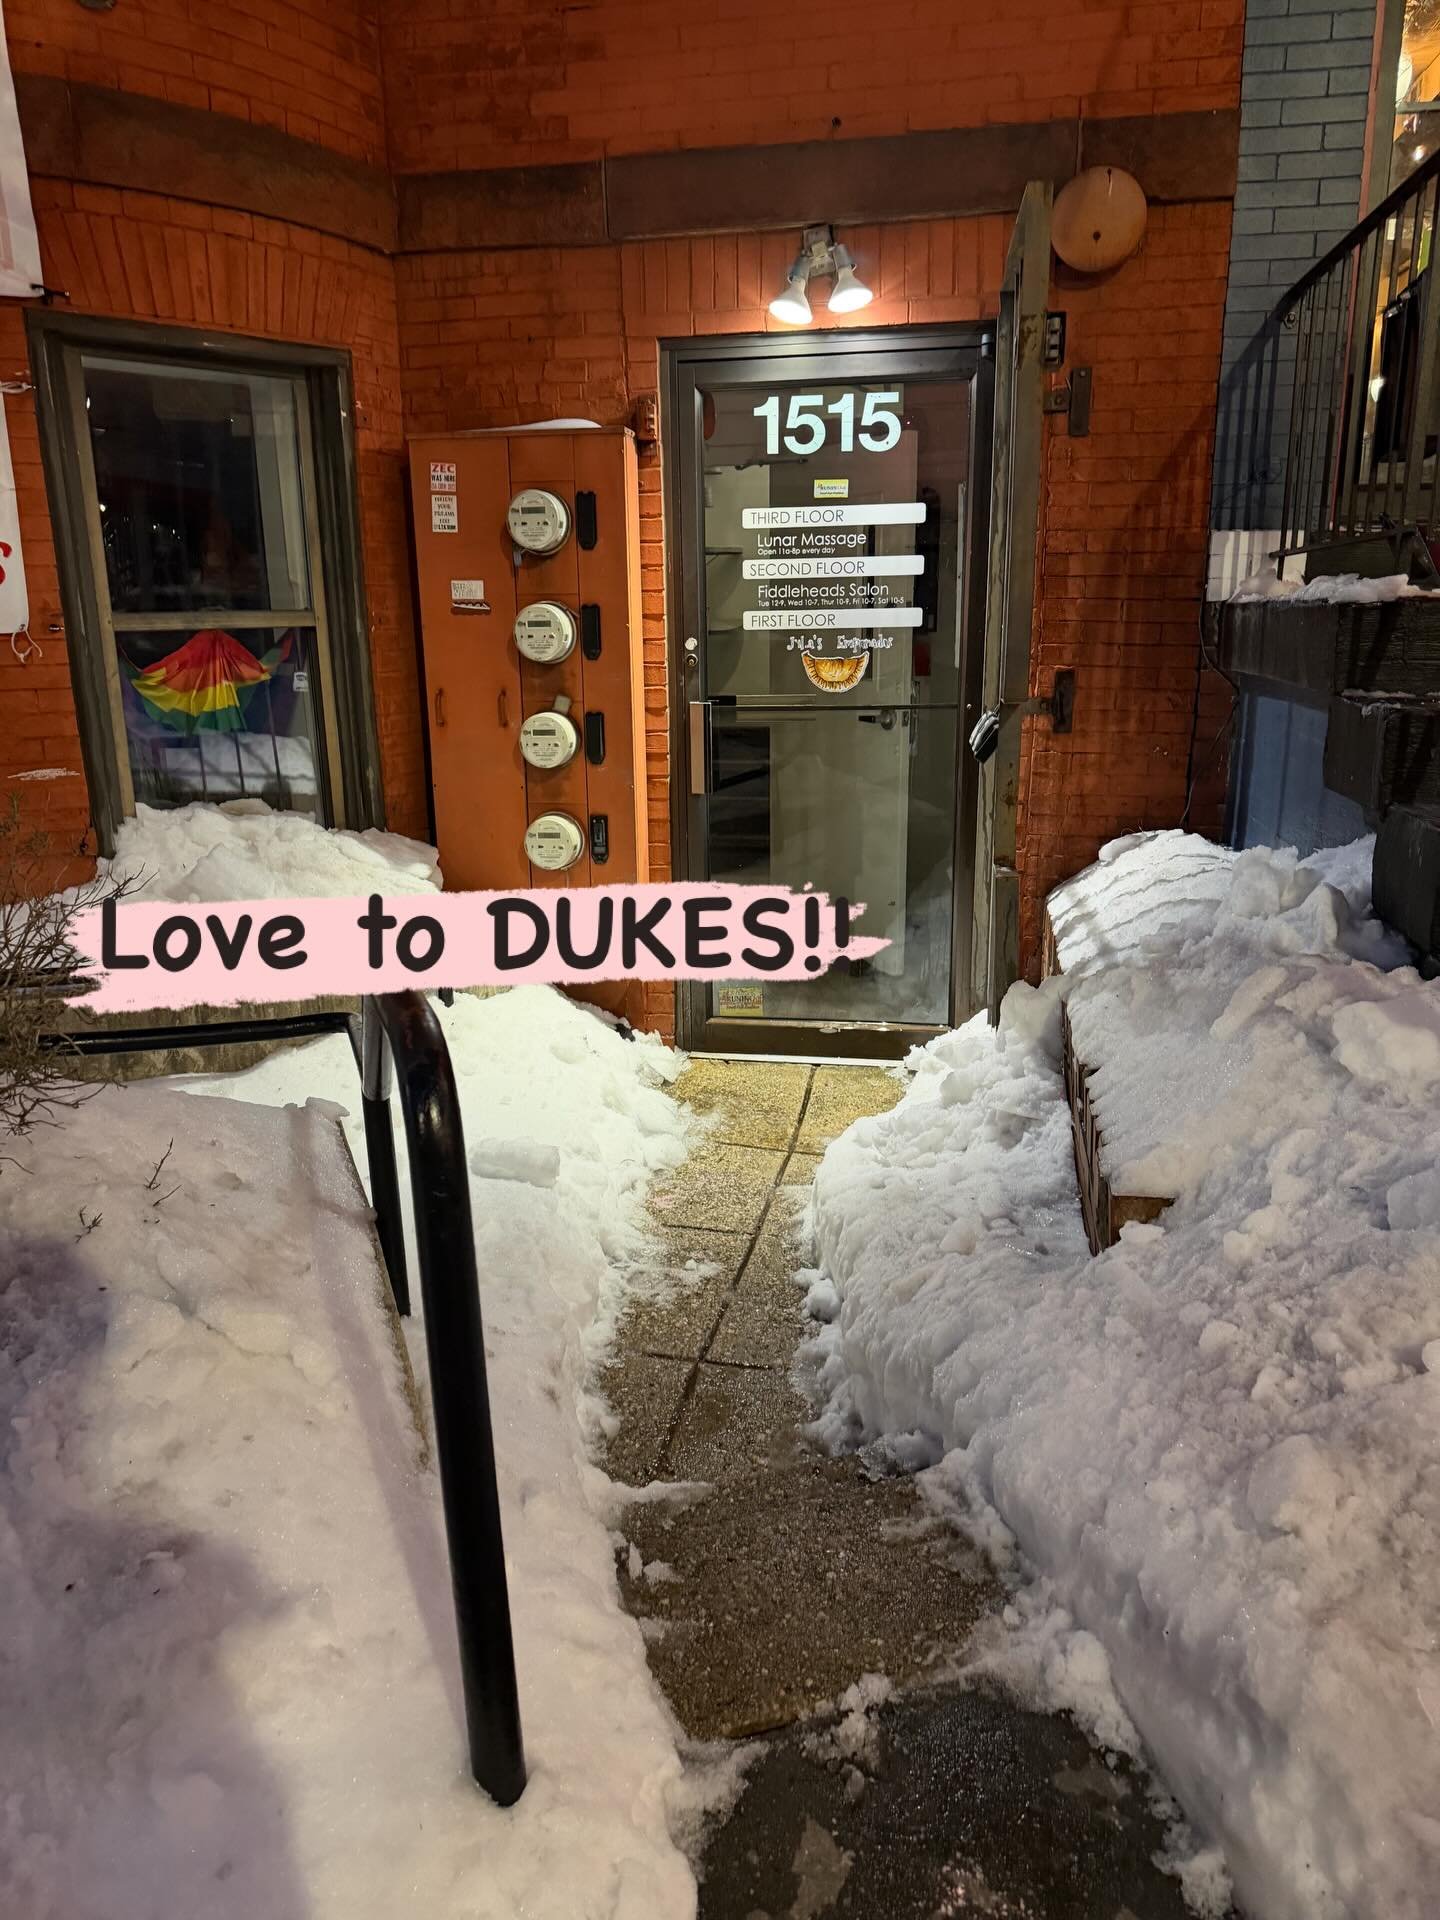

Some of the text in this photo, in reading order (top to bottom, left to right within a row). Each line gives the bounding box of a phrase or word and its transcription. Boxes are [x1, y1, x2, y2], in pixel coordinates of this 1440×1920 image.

[753, 391, 901, 455] 1515
[751, 509, 844, 525] THIRD FLOOR
[757, 533, 867, 548] Lunar Massage
[757, 548, 777, 556] Open
[802, 547, 820, 556] every
[821, 546, 836, 555] day
[750, 561, 865, 577] SECOND FLOOR
[757, 583, 889, 598] Fiddleheads Salon
[751, 613, 836, 627] FIRST FLOOR
